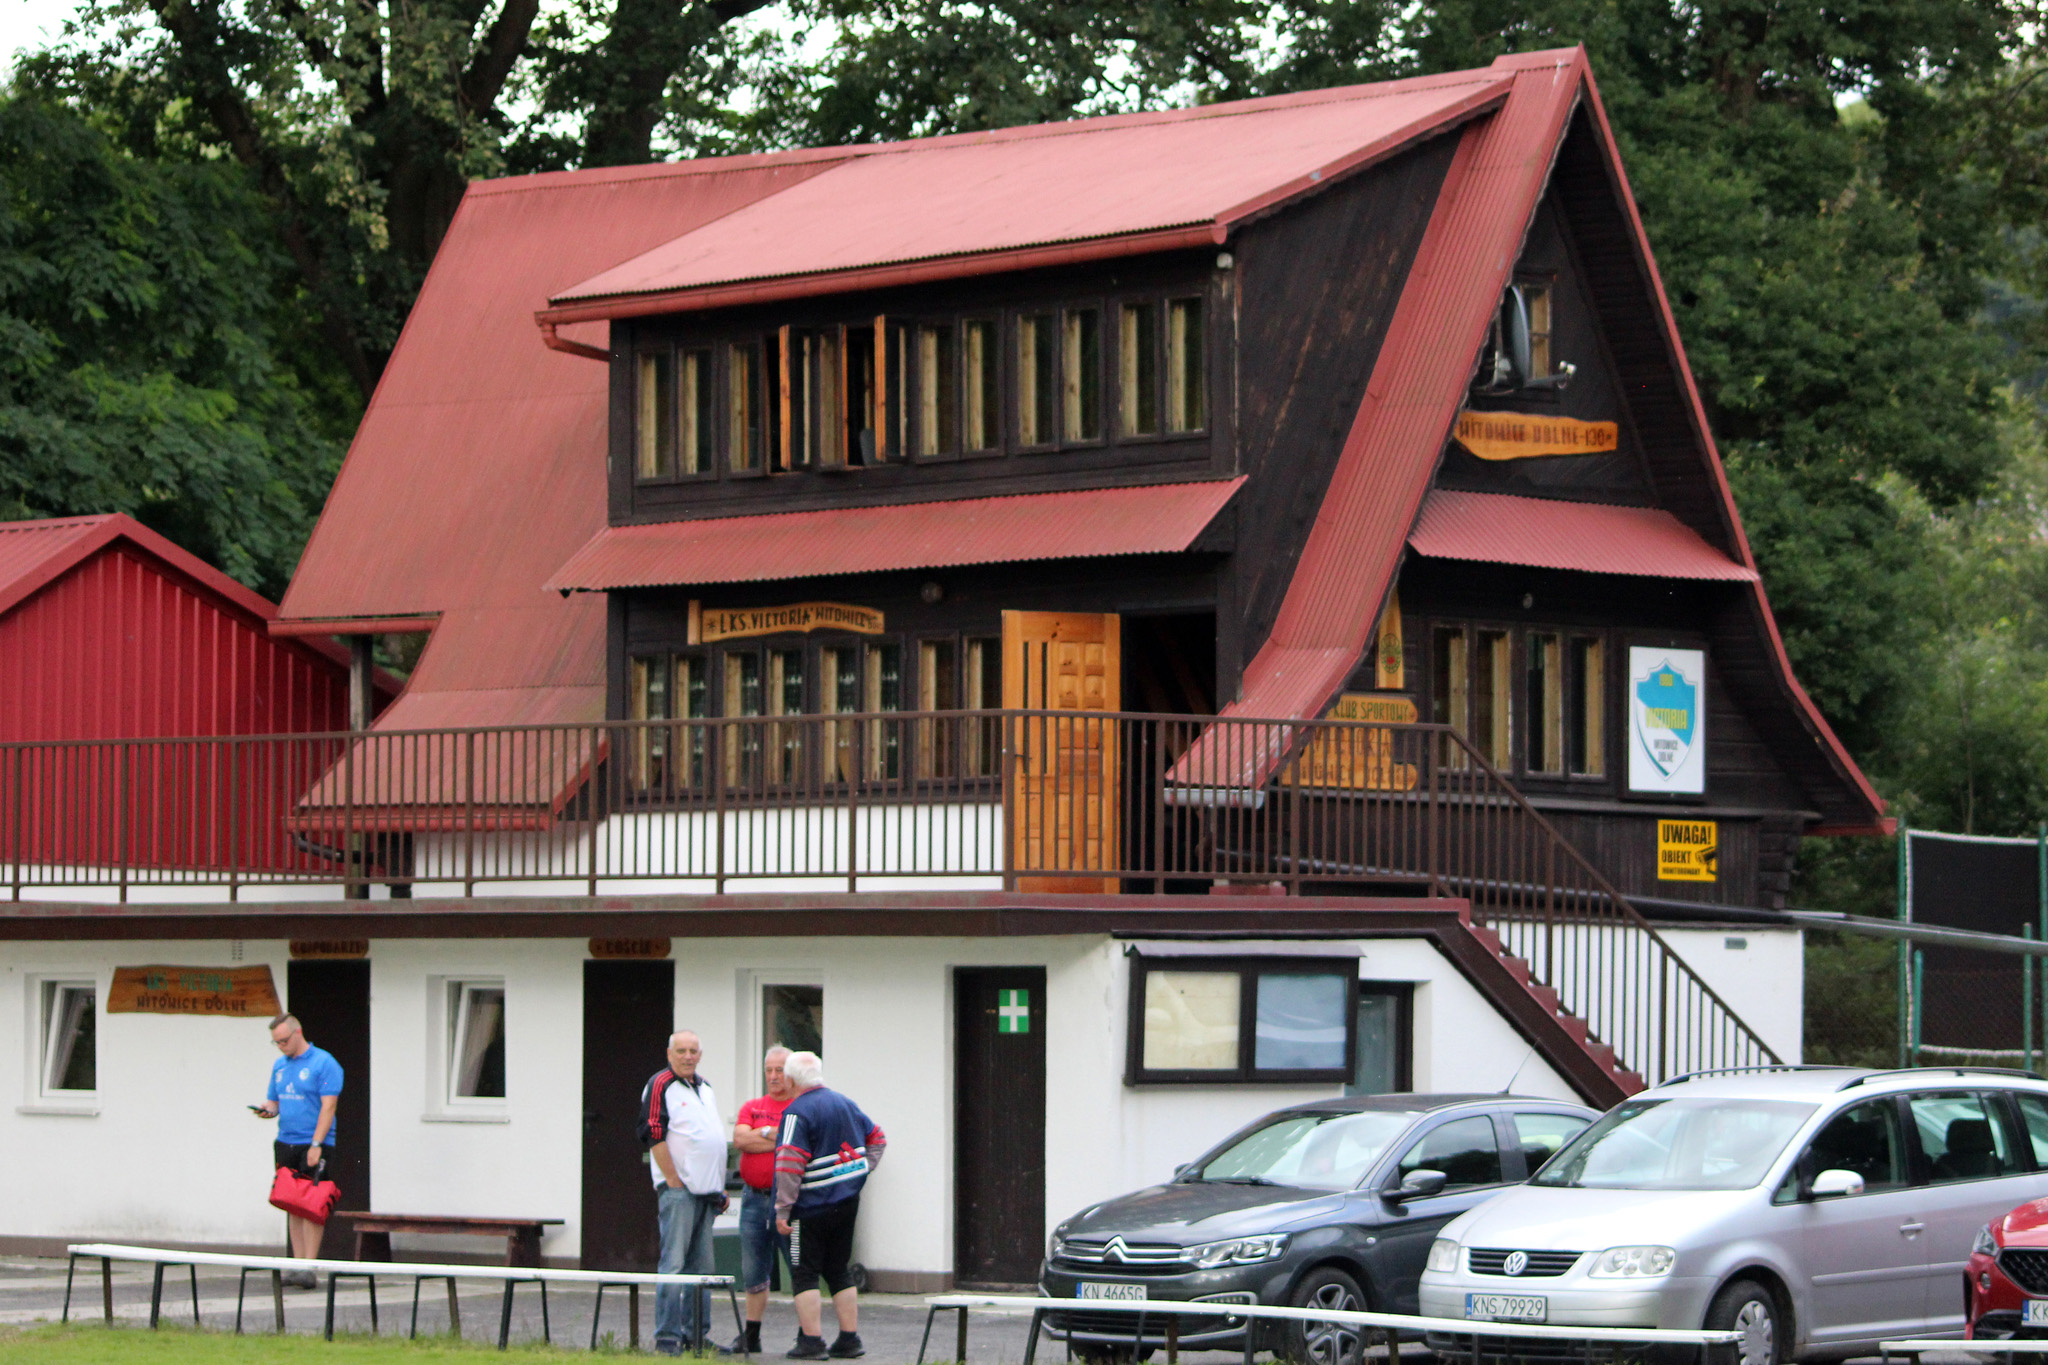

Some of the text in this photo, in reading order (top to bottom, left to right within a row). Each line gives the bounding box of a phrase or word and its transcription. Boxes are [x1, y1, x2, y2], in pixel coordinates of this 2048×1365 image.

[1360, 702, 1409, 722] SPORTOWY
[1645, 707, 1688, 729] VICTORIA
[1662, 824, 1711, 845] UWAGA!
[1662, 850, 1691, 864] OBIEKT
[1083, 1284, 1100, 1300] KN
[1104, 1285, 1143, 1301] 4665G
[1472, 1296, 1543, 1317] KNS 79929
